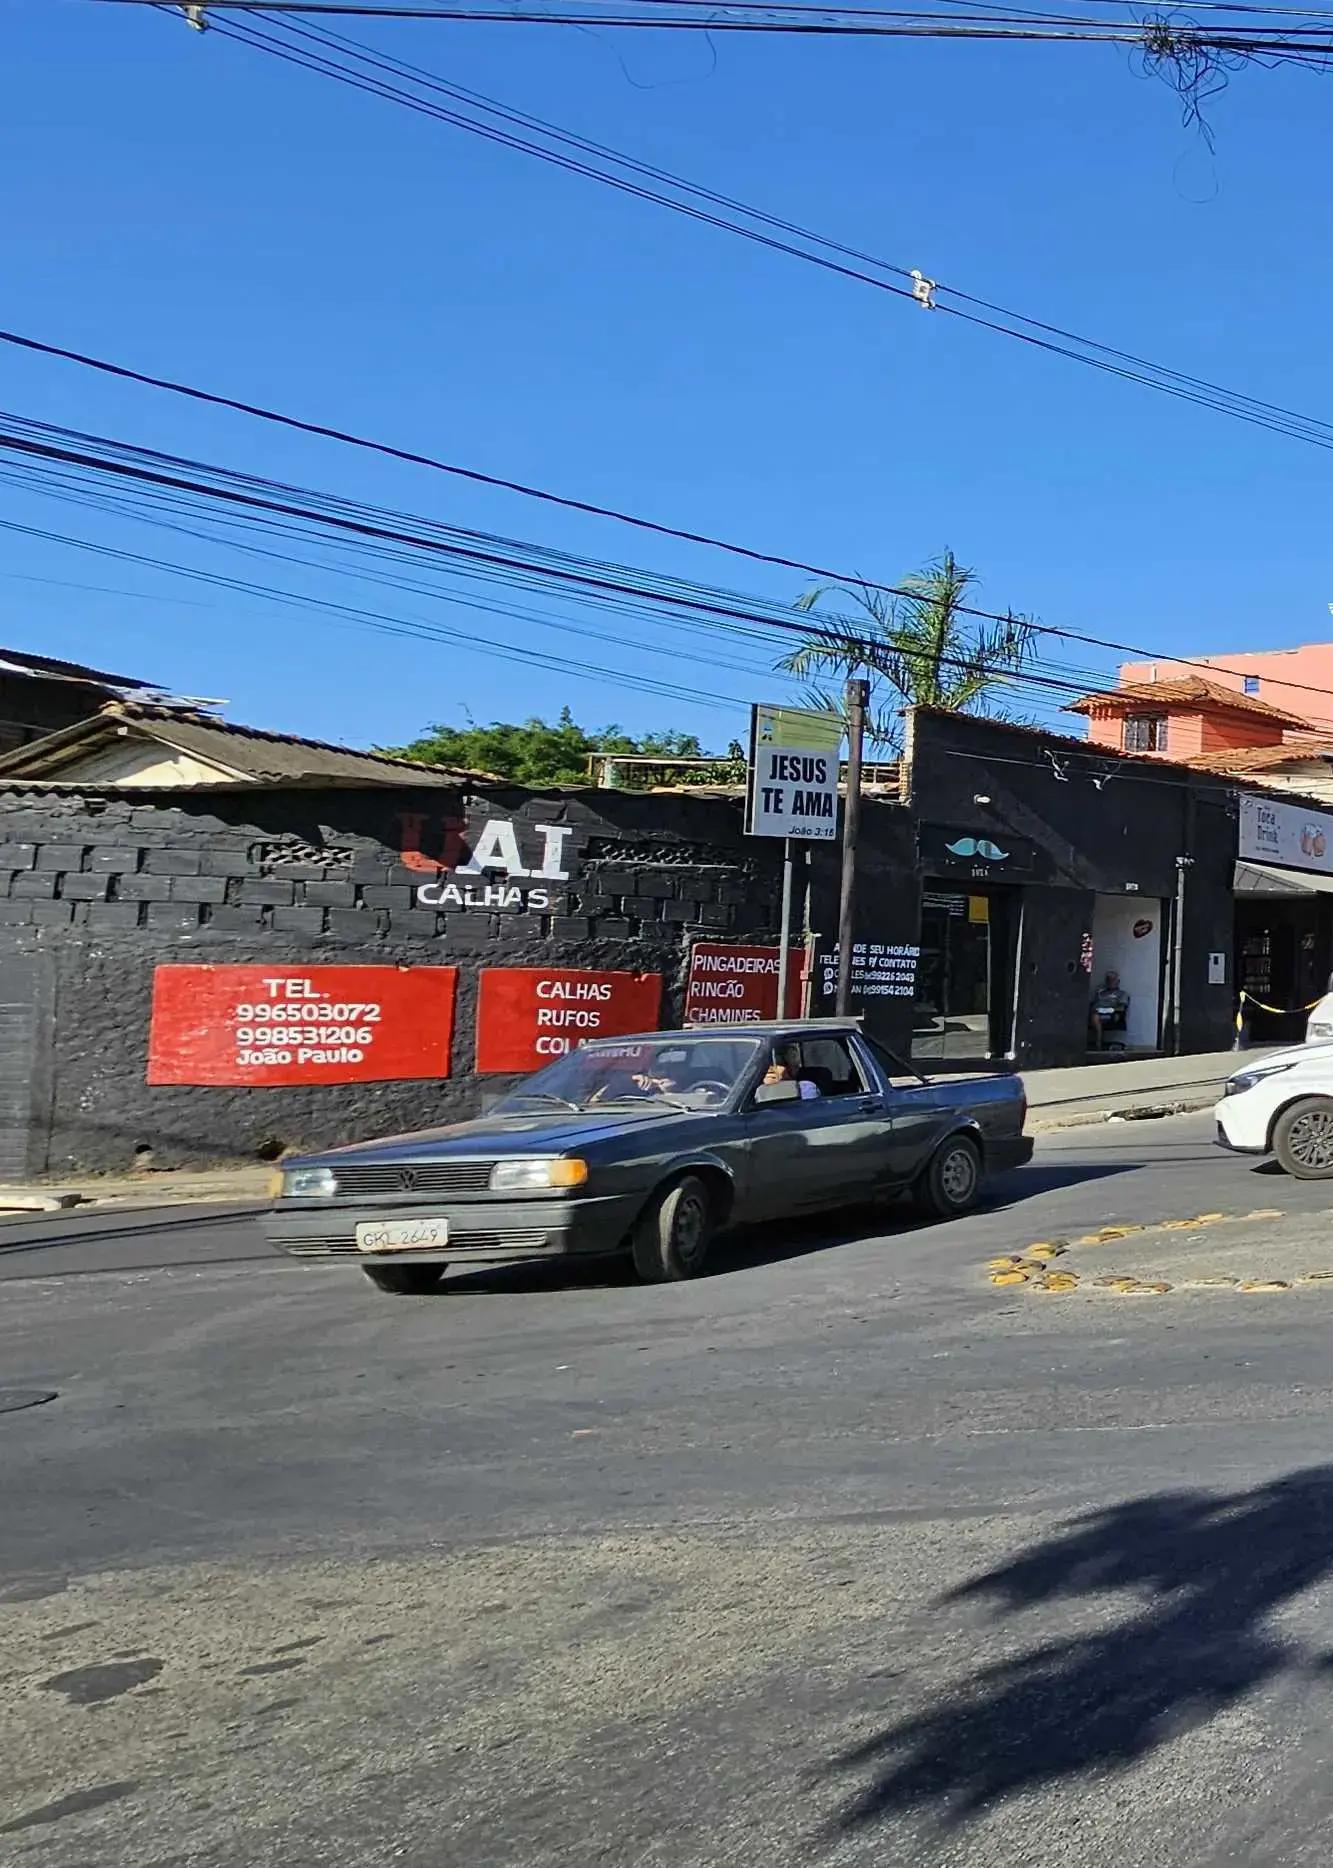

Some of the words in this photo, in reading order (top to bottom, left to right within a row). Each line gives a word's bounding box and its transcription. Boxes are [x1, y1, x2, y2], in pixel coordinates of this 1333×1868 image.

[769, 754, 827, 784] JESUS
[761, 787, 783, 814] TE
[791, 790, 833, 818] AMA
[788, 825, 812, 836] João
[396, 813, 572, 881] UAI
[416, 883, 551, 909] CALHAS
[869, 944, 884, 955] SEU
[694, 954, 781, 974] PINGADEIRAS
[879, 957, 917, 969] CONTATO
[262, 978, 331, 998] TEL.
[536, 980, 612, 1000] CALHAS
[691, 979, 745, 999] RINCÃO
[235, 1003, 382, 1022] 996503072
[537, 1008, 601, 1027] RUFOS
[235, 1026, 374, 1045] 998531206
[235, 1048, 292, 1065] João
[297, 1047, 364, 1064] Paulo
